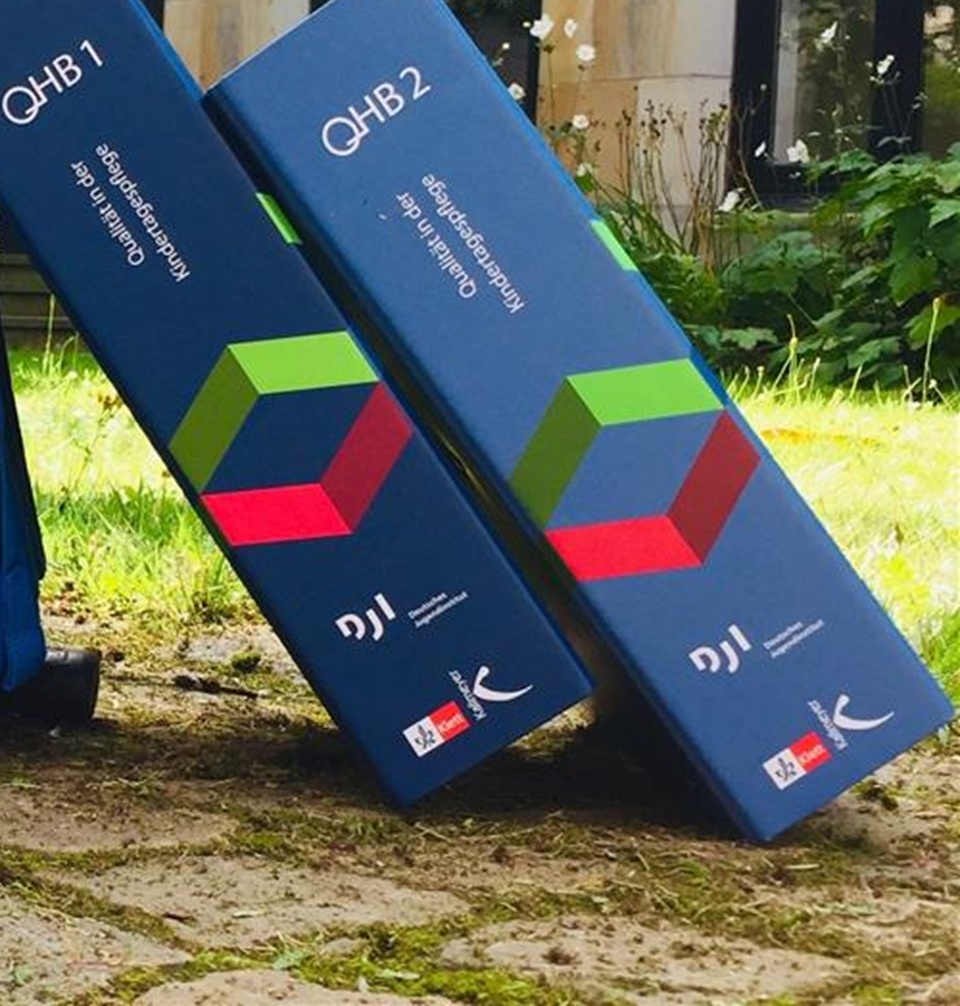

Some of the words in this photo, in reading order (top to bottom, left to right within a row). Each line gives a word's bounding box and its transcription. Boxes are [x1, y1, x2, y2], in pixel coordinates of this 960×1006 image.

[2, 53, 83, 125] QHB
[80, 39, 104, 68] 1
[321, 82, 405, 156] QHB
[399, 66, 431, 100] 2
[70, 161, 95, 186] der
[89, 186, 107, 208] in
[95, 143, 191, 283] Kindertagespflege
[396, 192, 422, 218] der
[417, 217, 436, 240] in
[99, 201, 145, 267] Qualität
[421, 173, 525, 314] Kindertagespflege
[428, 234, 478, 299] Qualität
[335, 593, 396, 641] DJI
[689, 624, 752, 673] DJI
